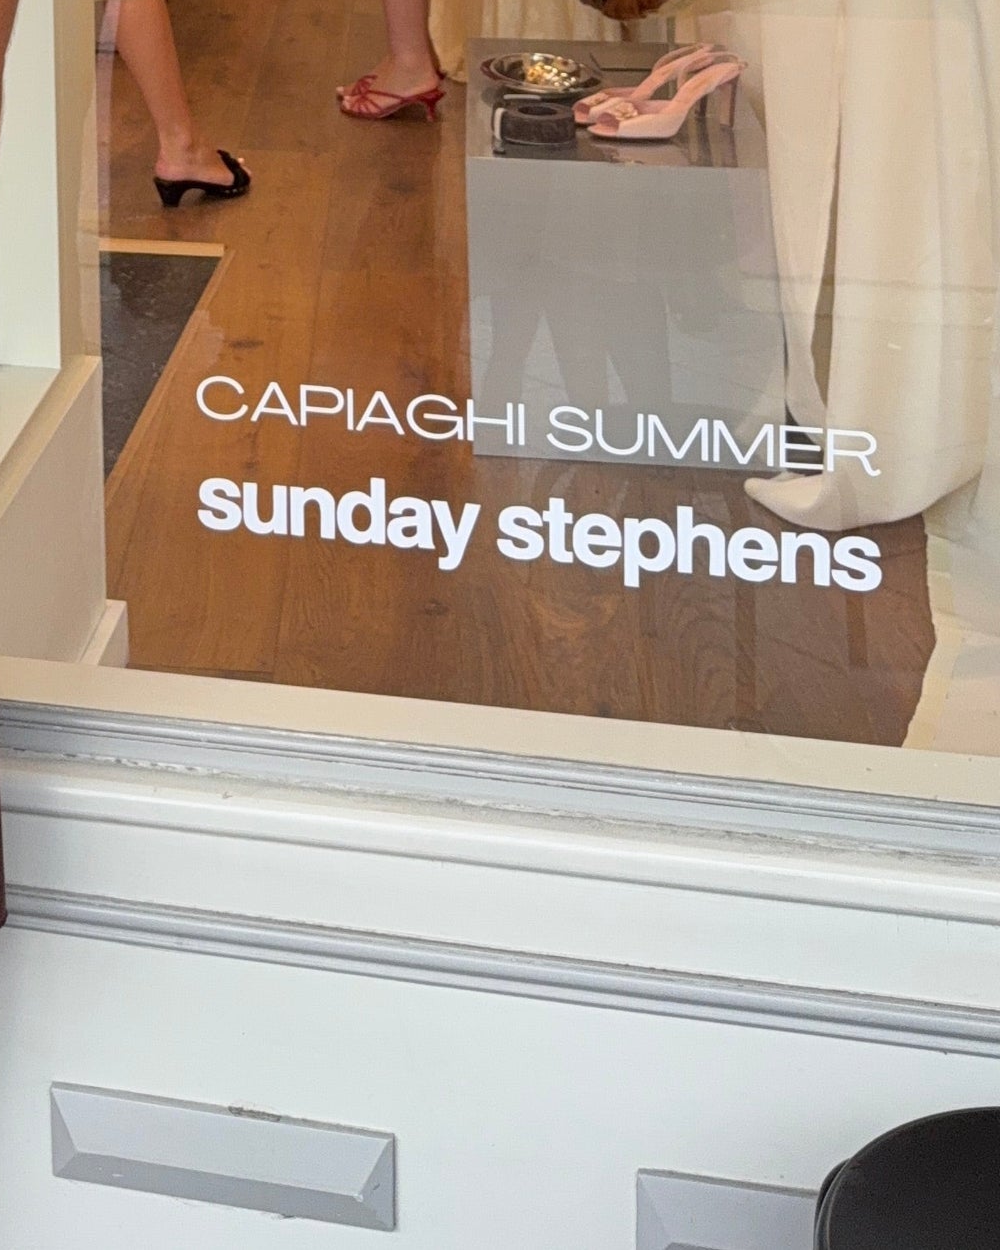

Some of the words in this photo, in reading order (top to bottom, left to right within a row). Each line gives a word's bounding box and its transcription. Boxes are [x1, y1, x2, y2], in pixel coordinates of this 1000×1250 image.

[195, 375, 526, 446] CAPIAGHI
[546, 405, 881, 477] SUMMER
[197, 476, 481, 571] sunday
[496, 496, 883, 592] stephens
